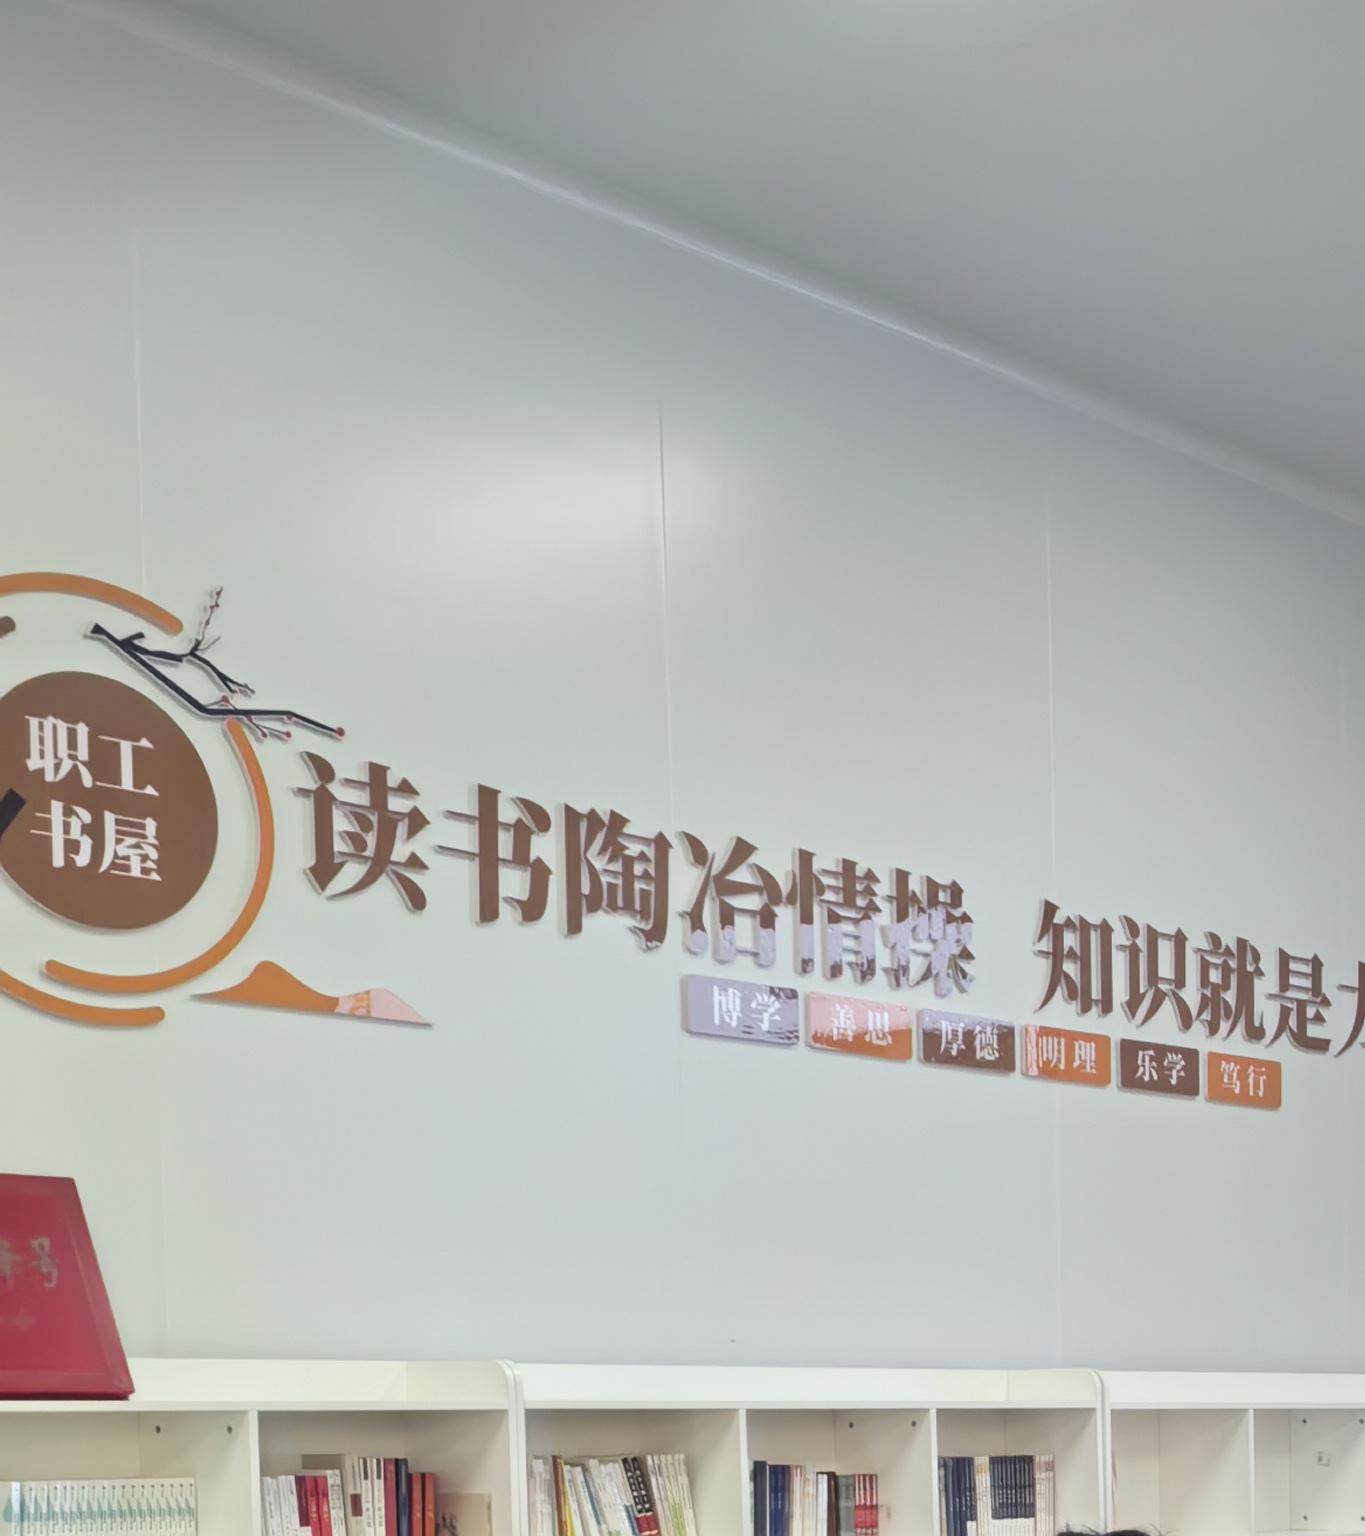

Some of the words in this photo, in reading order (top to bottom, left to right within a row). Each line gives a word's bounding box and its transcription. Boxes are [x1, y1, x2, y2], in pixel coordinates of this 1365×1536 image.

[25, 714, 160, 798] 职工
[30, 799, 163, 882] 书屋
[291, 750, 976, 998] 读书陶冶情操
[713, 985, 782, 1032] 博学
[939, 1019, 1000, 1061] 厚德
[1038, 1035, 1098, 1075] 明理
[1134, 1049, 1187, 1085] 乐学
[1220, 1060, 1268, 1098] 笃行
